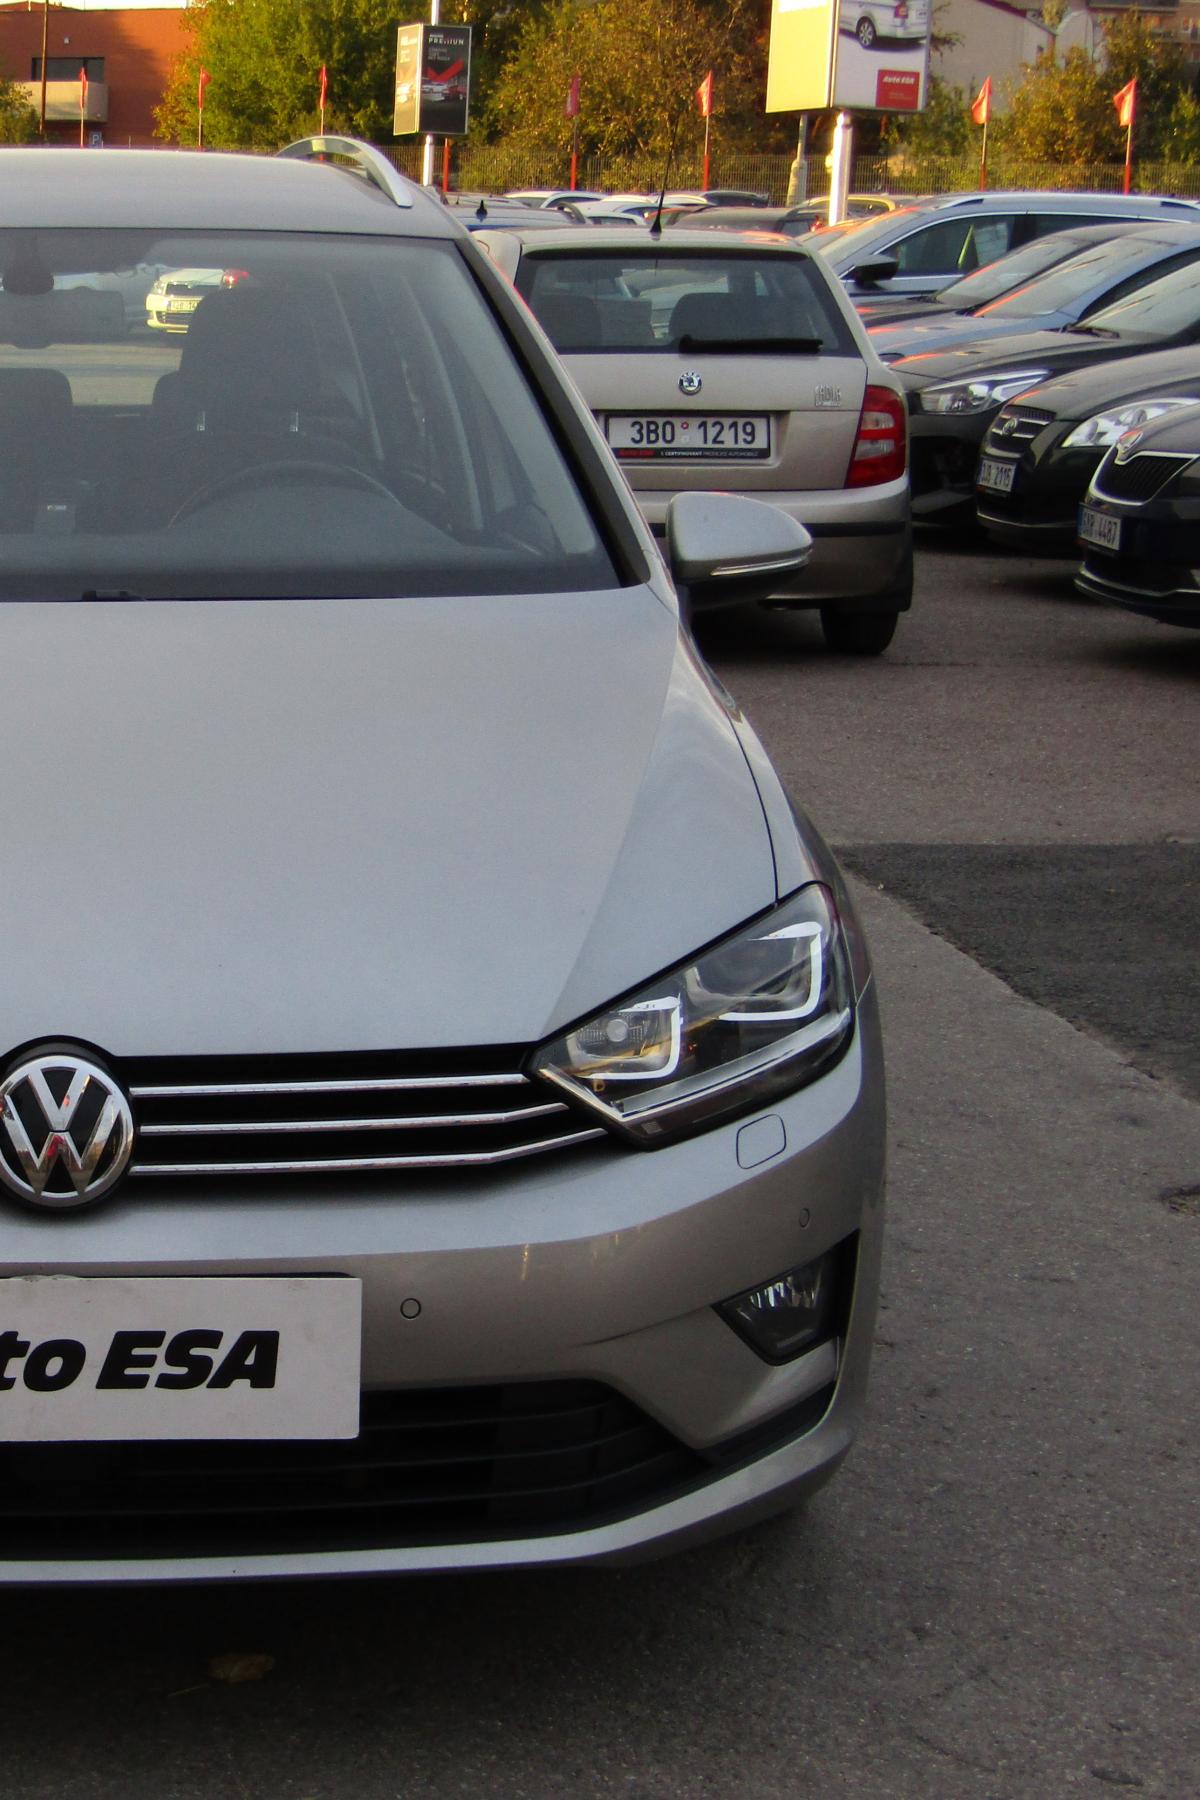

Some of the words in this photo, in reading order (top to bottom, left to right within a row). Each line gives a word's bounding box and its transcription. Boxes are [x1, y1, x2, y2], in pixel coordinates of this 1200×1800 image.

[630, 420, 675, 445] 3B0
[697, 420, 756, 445] 1219
[95, 1330, 280, 1390] ESA
